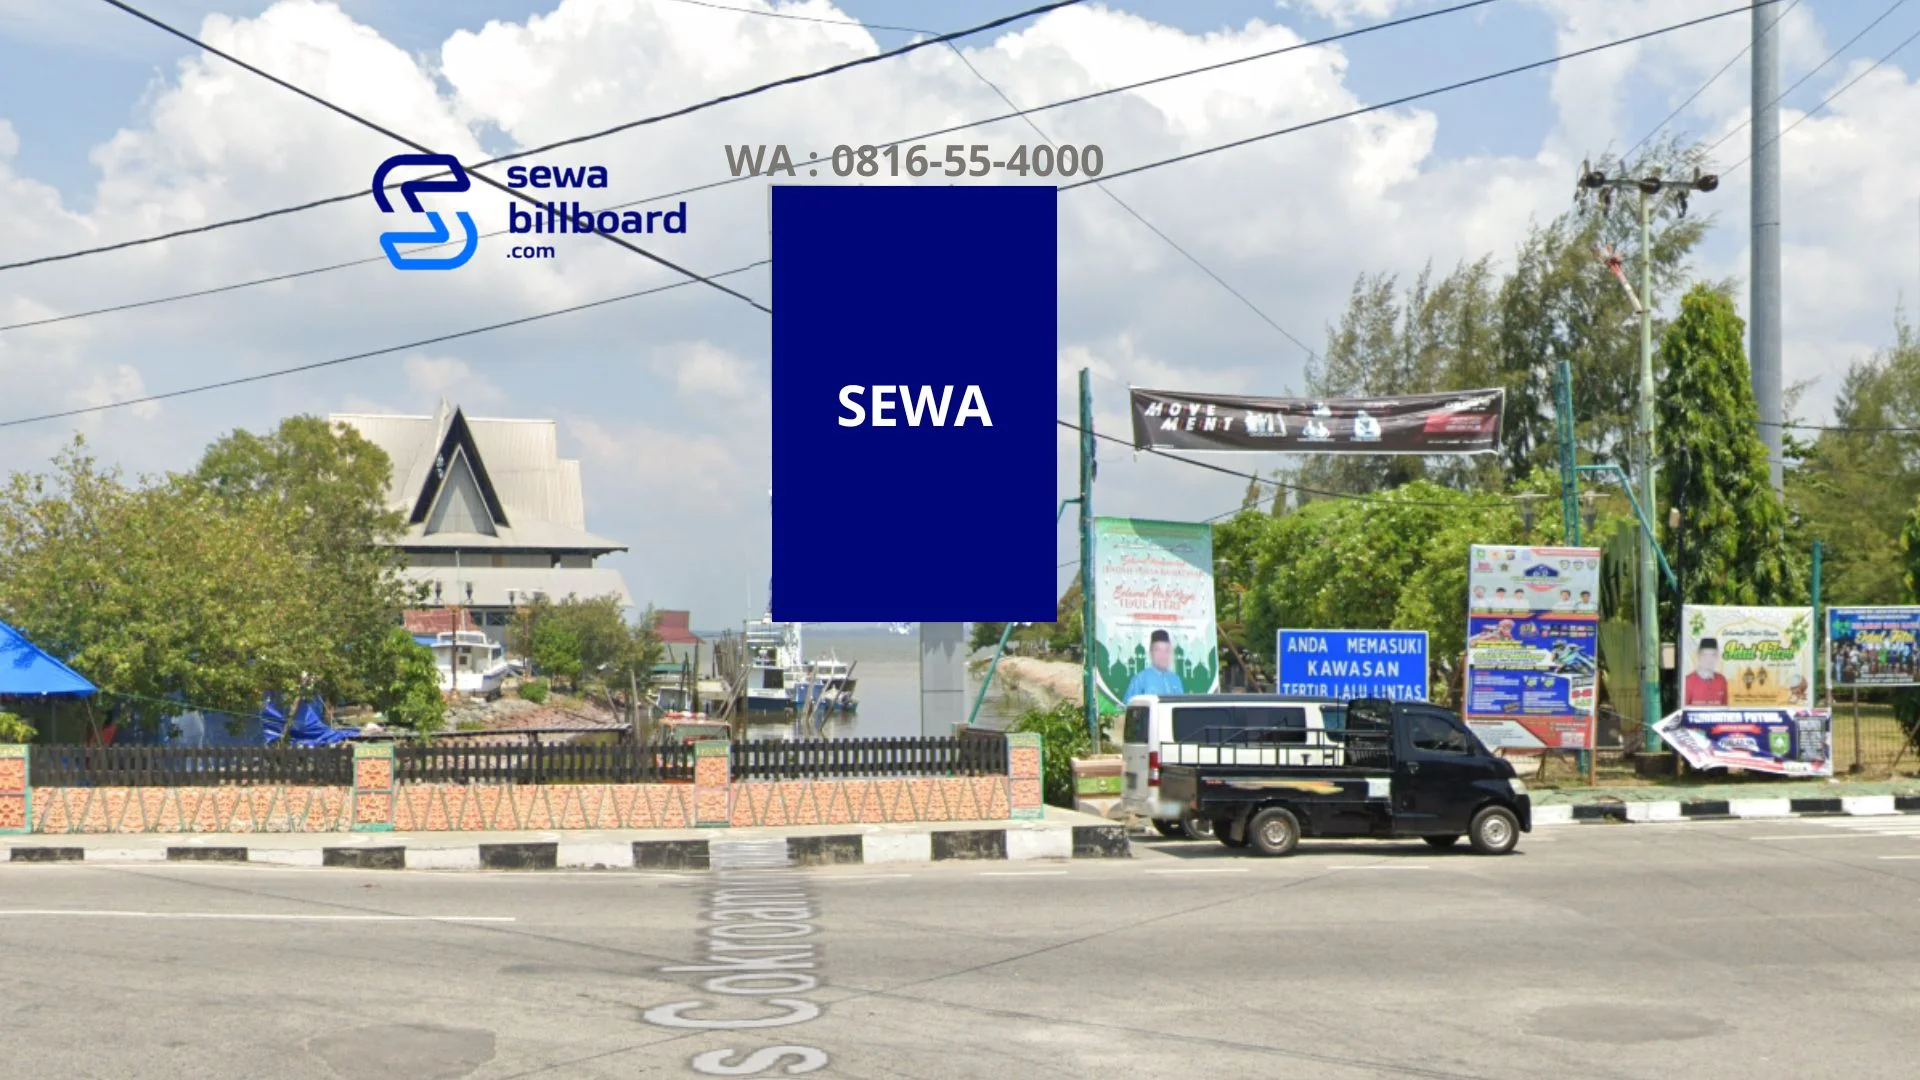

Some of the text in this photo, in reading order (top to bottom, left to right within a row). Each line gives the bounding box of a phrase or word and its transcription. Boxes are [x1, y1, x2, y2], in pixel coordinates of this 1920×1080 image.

[1287, 636, 1422, 654] ANDA MEMASUKI
[1307, 659, 1400, 677] KAWASAN
[1283, 683, 1328, 697] TERTIB
